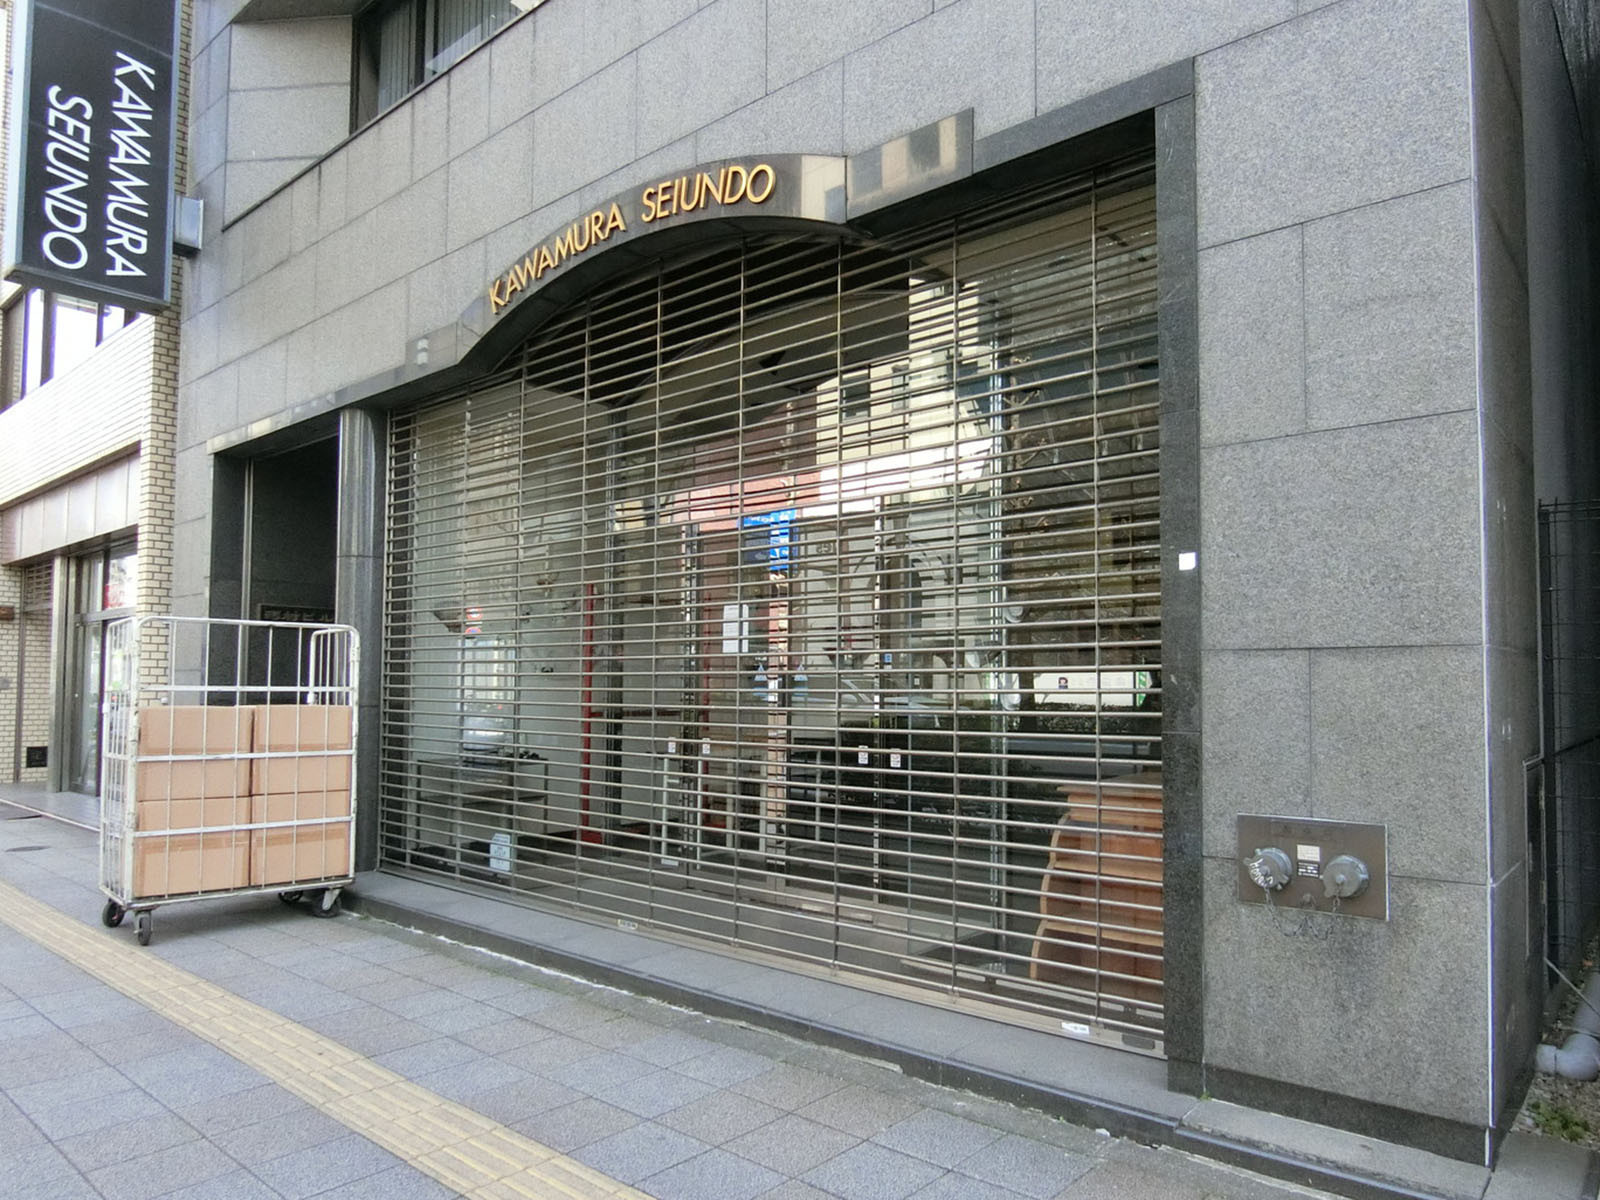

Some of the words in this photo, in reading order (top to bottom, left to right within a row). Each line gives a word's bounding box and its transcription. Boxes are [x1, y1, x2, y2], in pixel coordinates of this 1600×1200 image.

[42, 85, 94, 270] SEIUNDO
[105, 51, 156, 278] KAWAMURA
[488, 202, 627, 314] KAWAMURA
[641, 164, 776, 223] SEIUNDO
